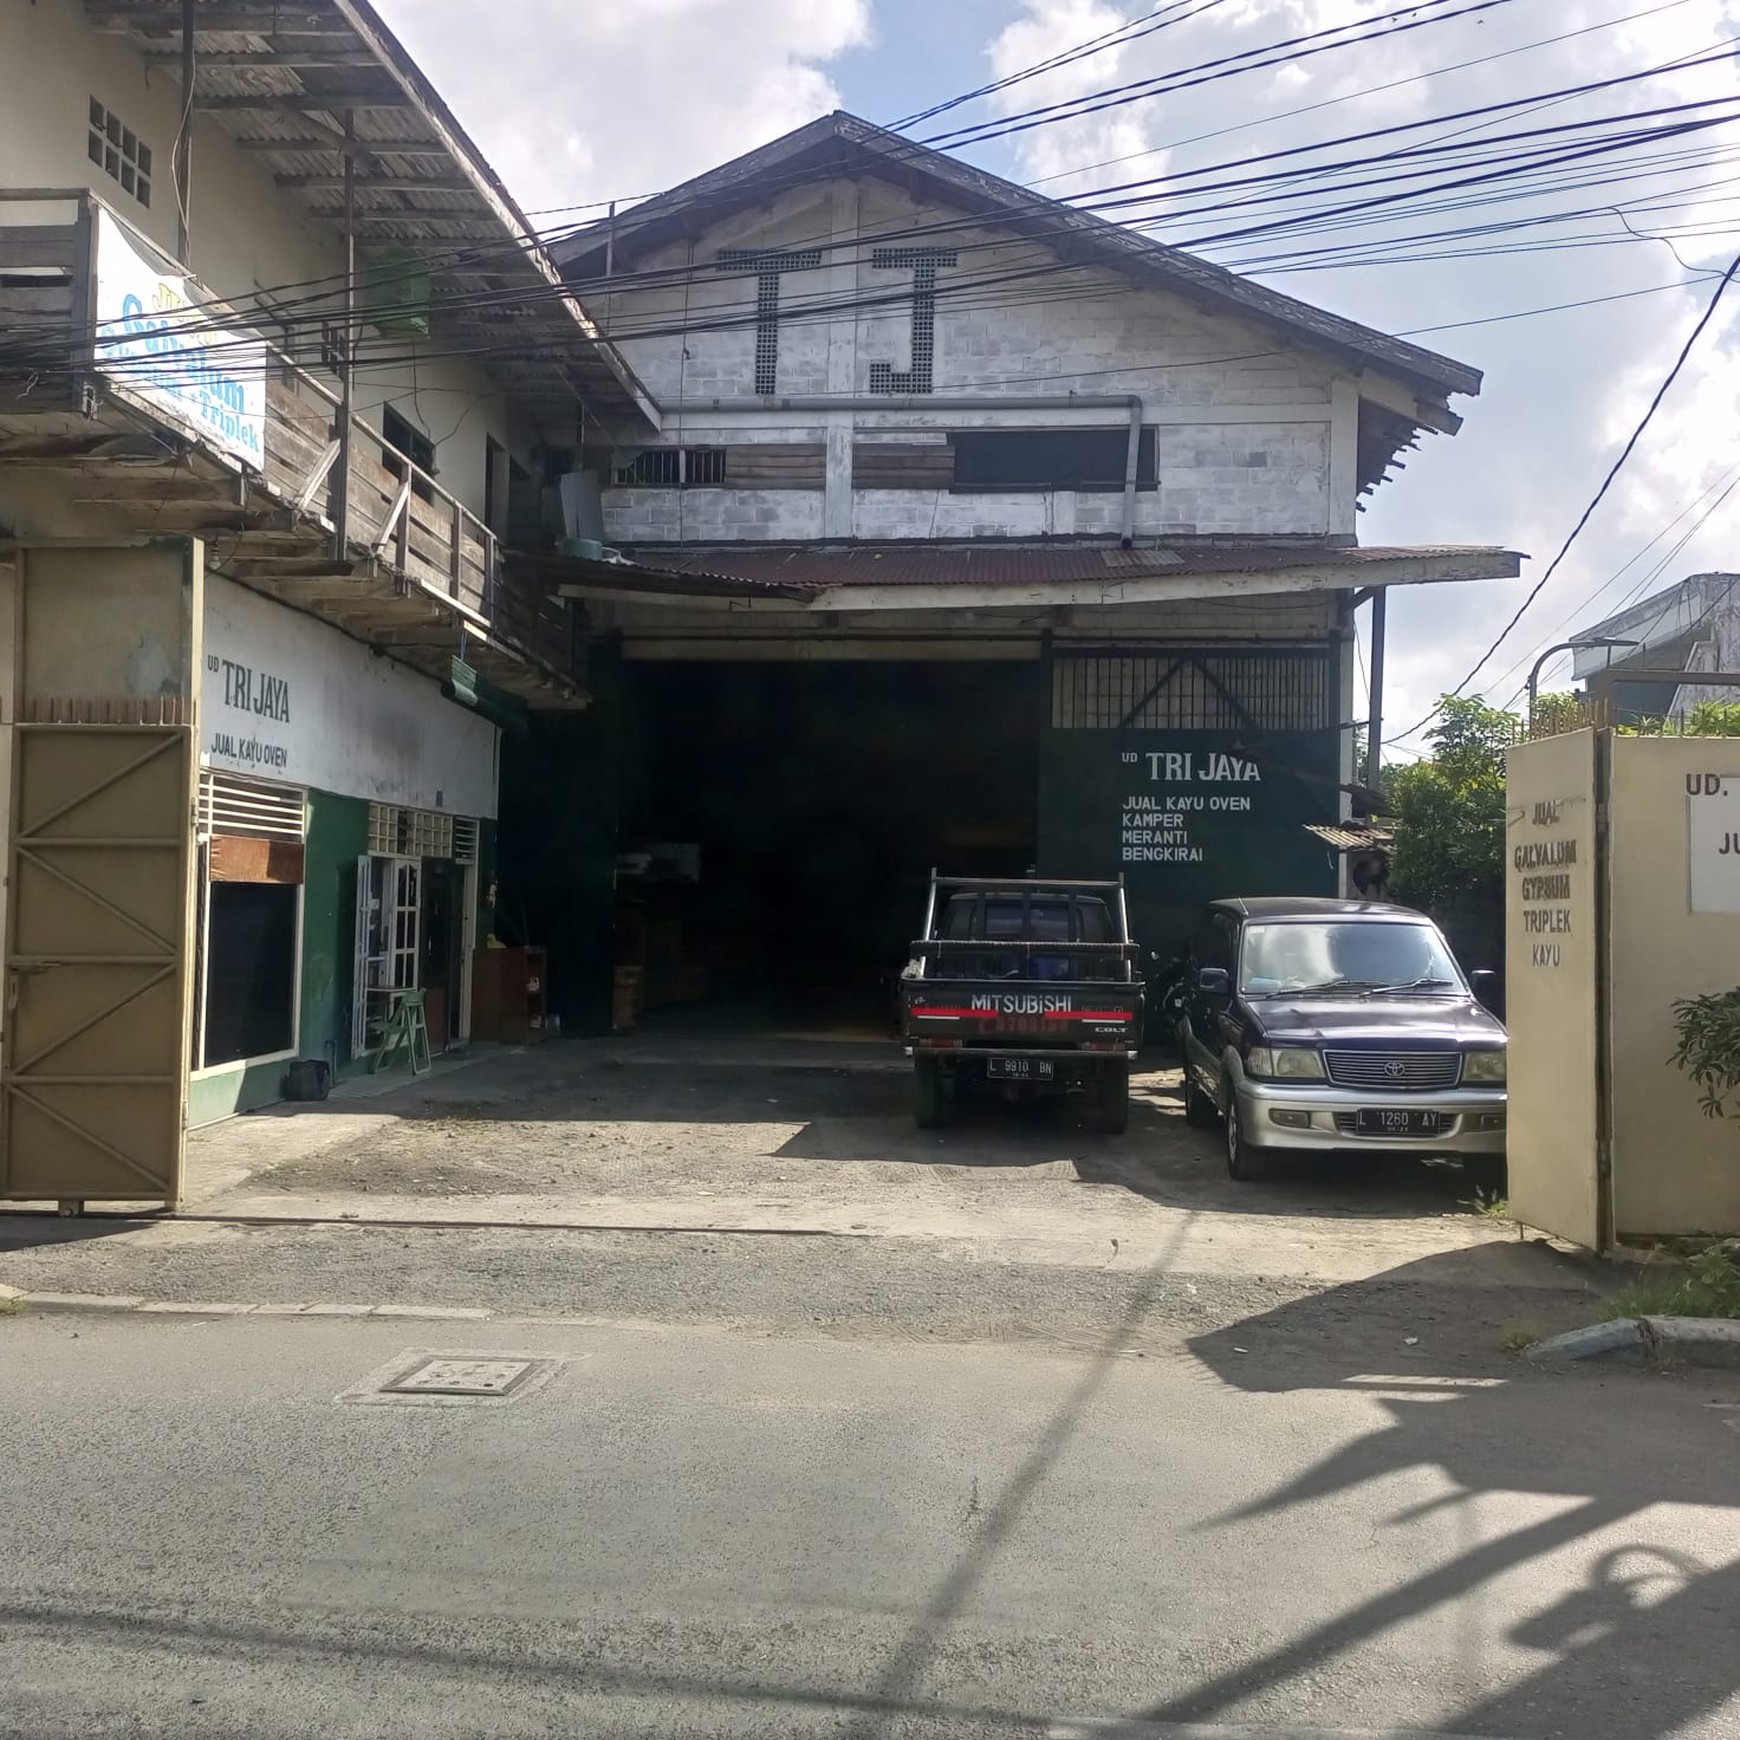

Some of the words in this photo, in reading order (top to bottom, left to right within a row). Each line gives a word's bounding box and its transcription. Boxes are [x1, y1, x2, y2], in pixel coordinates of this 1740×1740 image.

[198, 389, 260, 453] Triplek
[207, 655, 219, 673] UD
[222, 660, 252, 710] TRI
[253, 672, 290, 723] JAYA
[211, 732, 237, 759] JUAL
[238, 736, 263, 763] KAYU
[263, 744, 287, 768] OVEN
[1122, 752, 1138, 763] UD
[1146, 752, 1193, 781] TRI
[1197, 753, 1261, 781] JAYA
[1685, 773, 1729, 797] UD.
[1123, 796, 1161, 811] JUAL
[1166, 796, 1204, 811] KAYU
[1210, 797, 1251, 811] OVEN
[1123, 813, 1184, 828] KAMPER
[1123, 830, 1188, 845] MERANTI
[1123, 847, 1203, 862] BENGKIRAI
[1523, 909, 1571, 933] TRIPLEK
[1532, 943, 1561, 968] KAYU
[989, 1059, 997, 1071] L
[1359, 1112, 1366, 1126] L
[1380, 1111, 1409, 1126] 1260
[1422, 1112, 1437, 1126] AY
